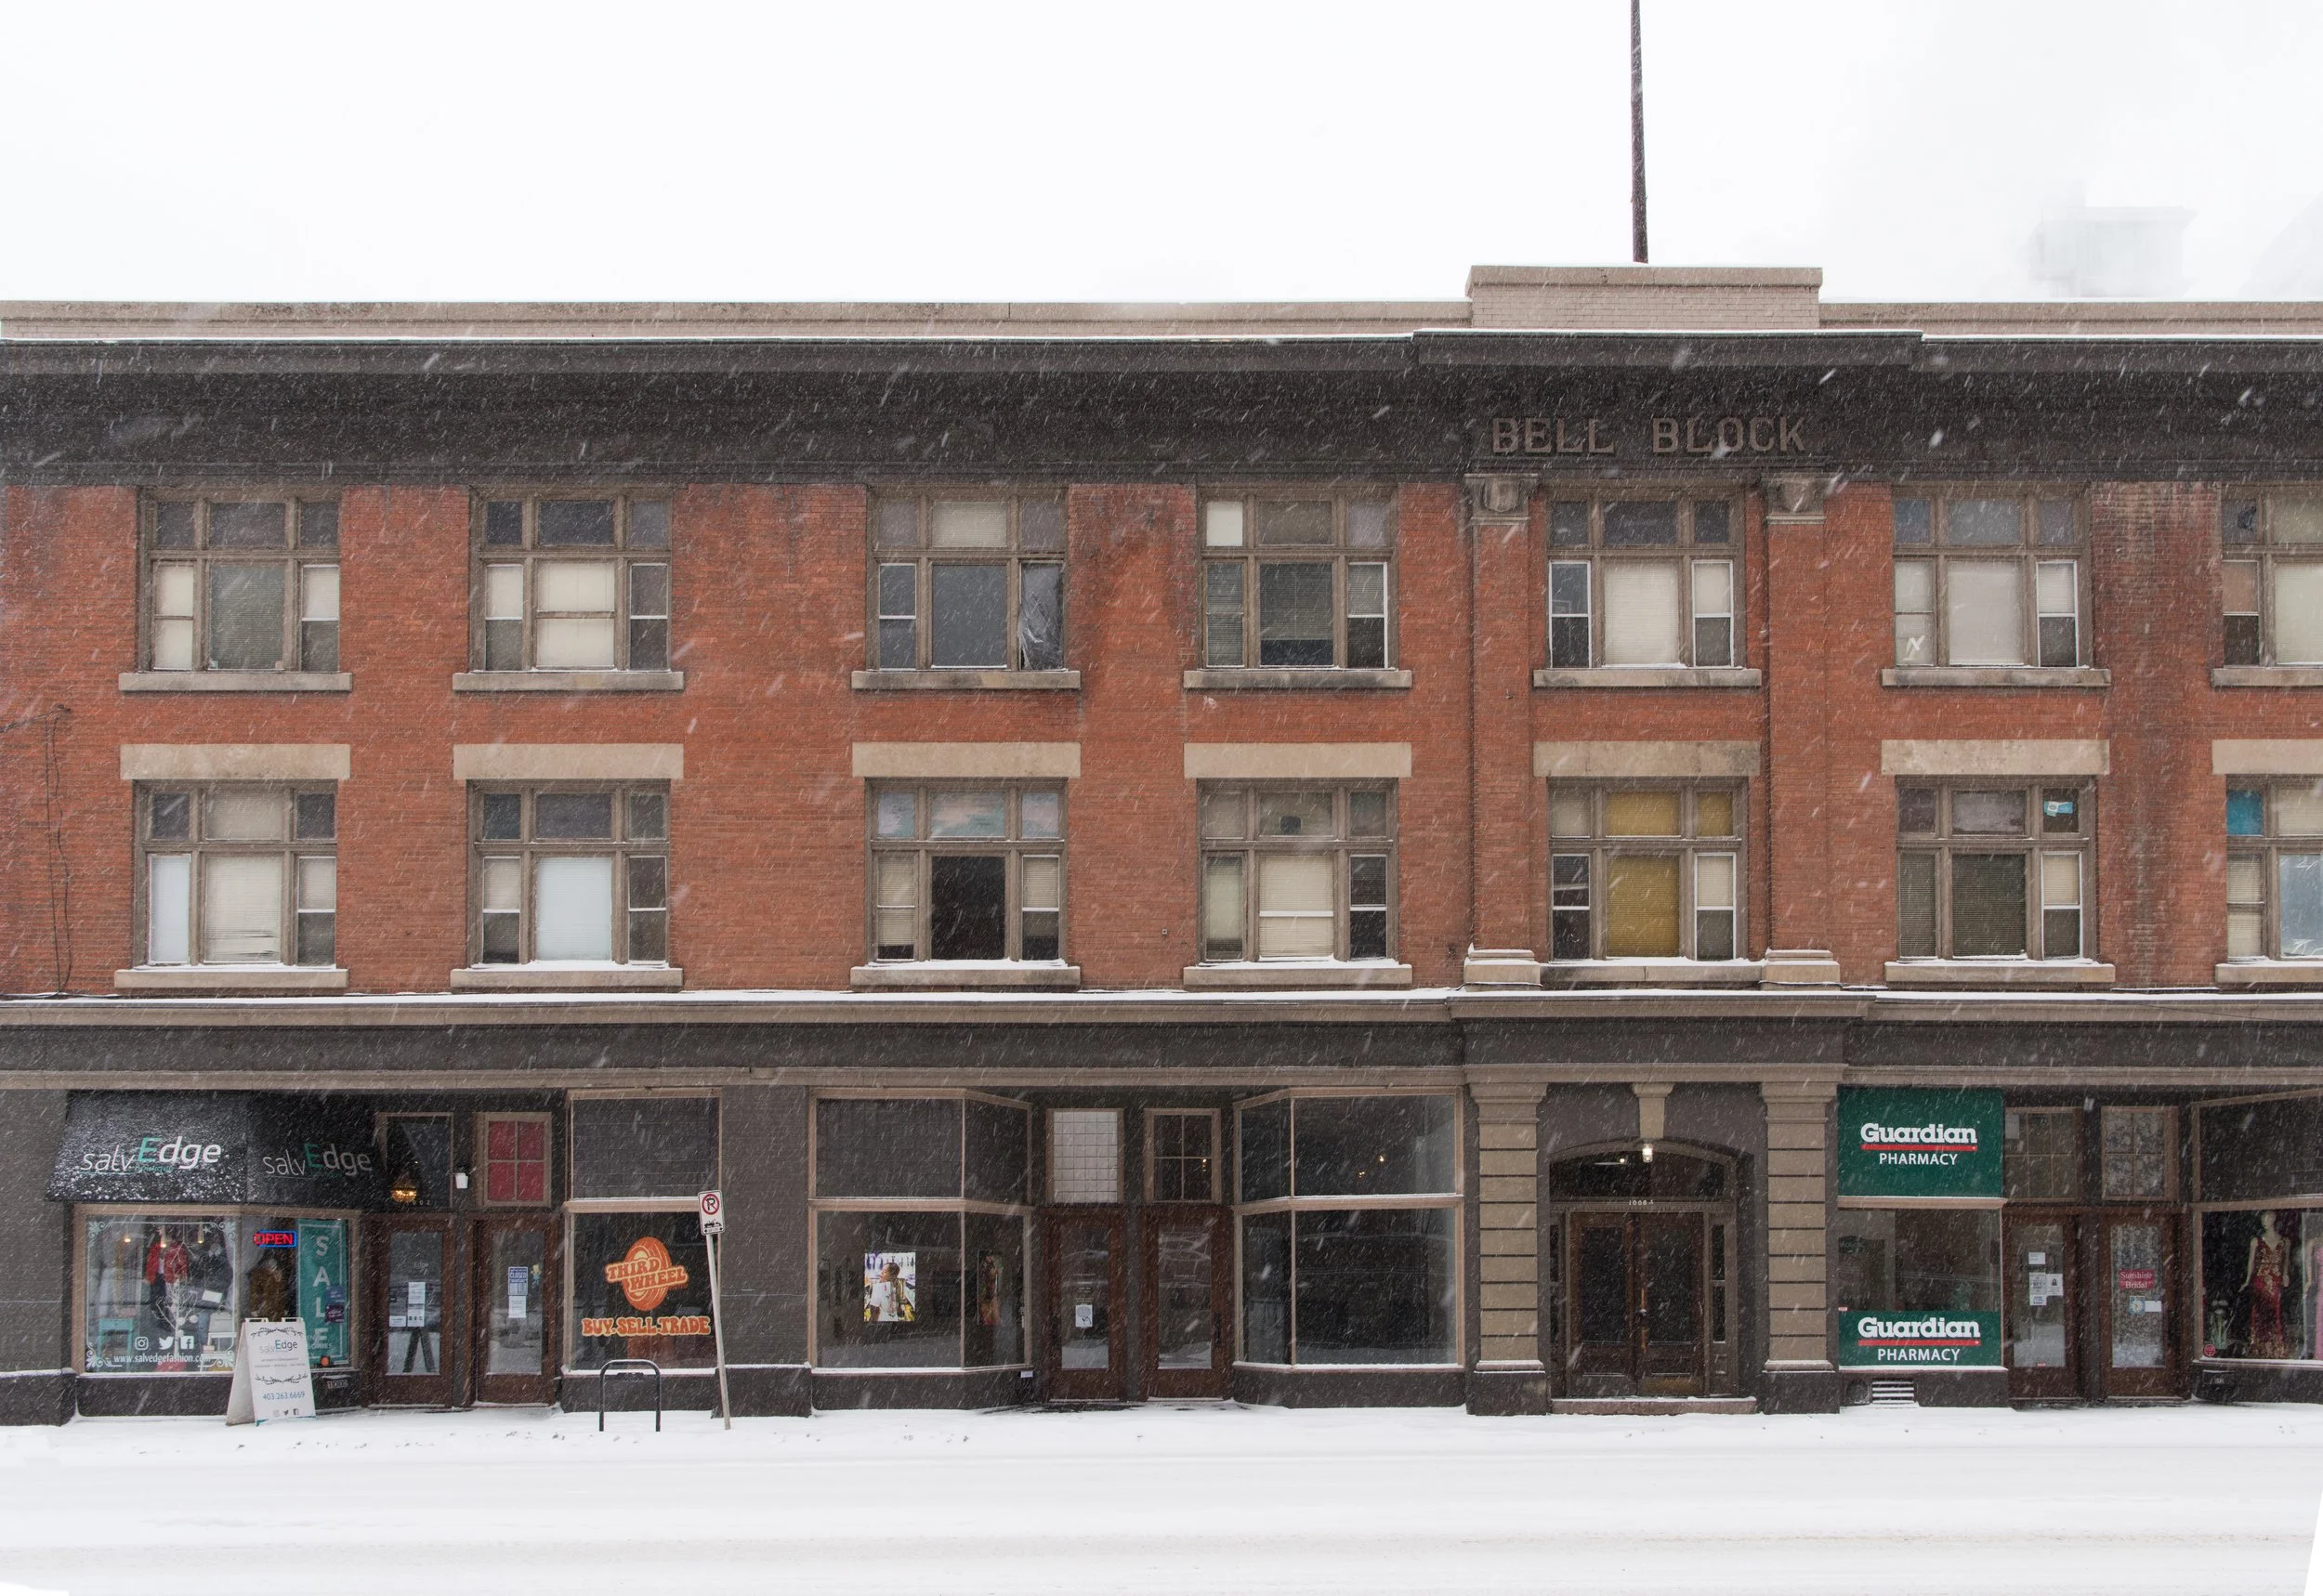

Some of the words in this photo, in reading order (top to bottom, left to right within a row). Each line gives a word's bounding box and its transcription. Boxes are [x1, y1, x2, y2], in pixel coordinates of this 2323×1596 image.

[1492, 417, 1615, 454] BELL
[1652, 417, 1805, 453] BLOCK
[1860, 1122, 1977, 1144] Guardian
[1879, 1153, 1958, 1166] PHARMACY
[254, 1233, 294, 1245] OPEN
[607, 1258, 661, 1281] THIRD
[629, 1269, 687, 1291] WHEEL
[2120, 1271, 2153, 1279] Sunshine
[312, 1235, 331, 1348] SALE
[1857, 1316, 1981, 1339] Guardian
[1878, 1348, 1961, 1361] PHARMACY
[262, 1391, 306, 1400] 403.263.6669
